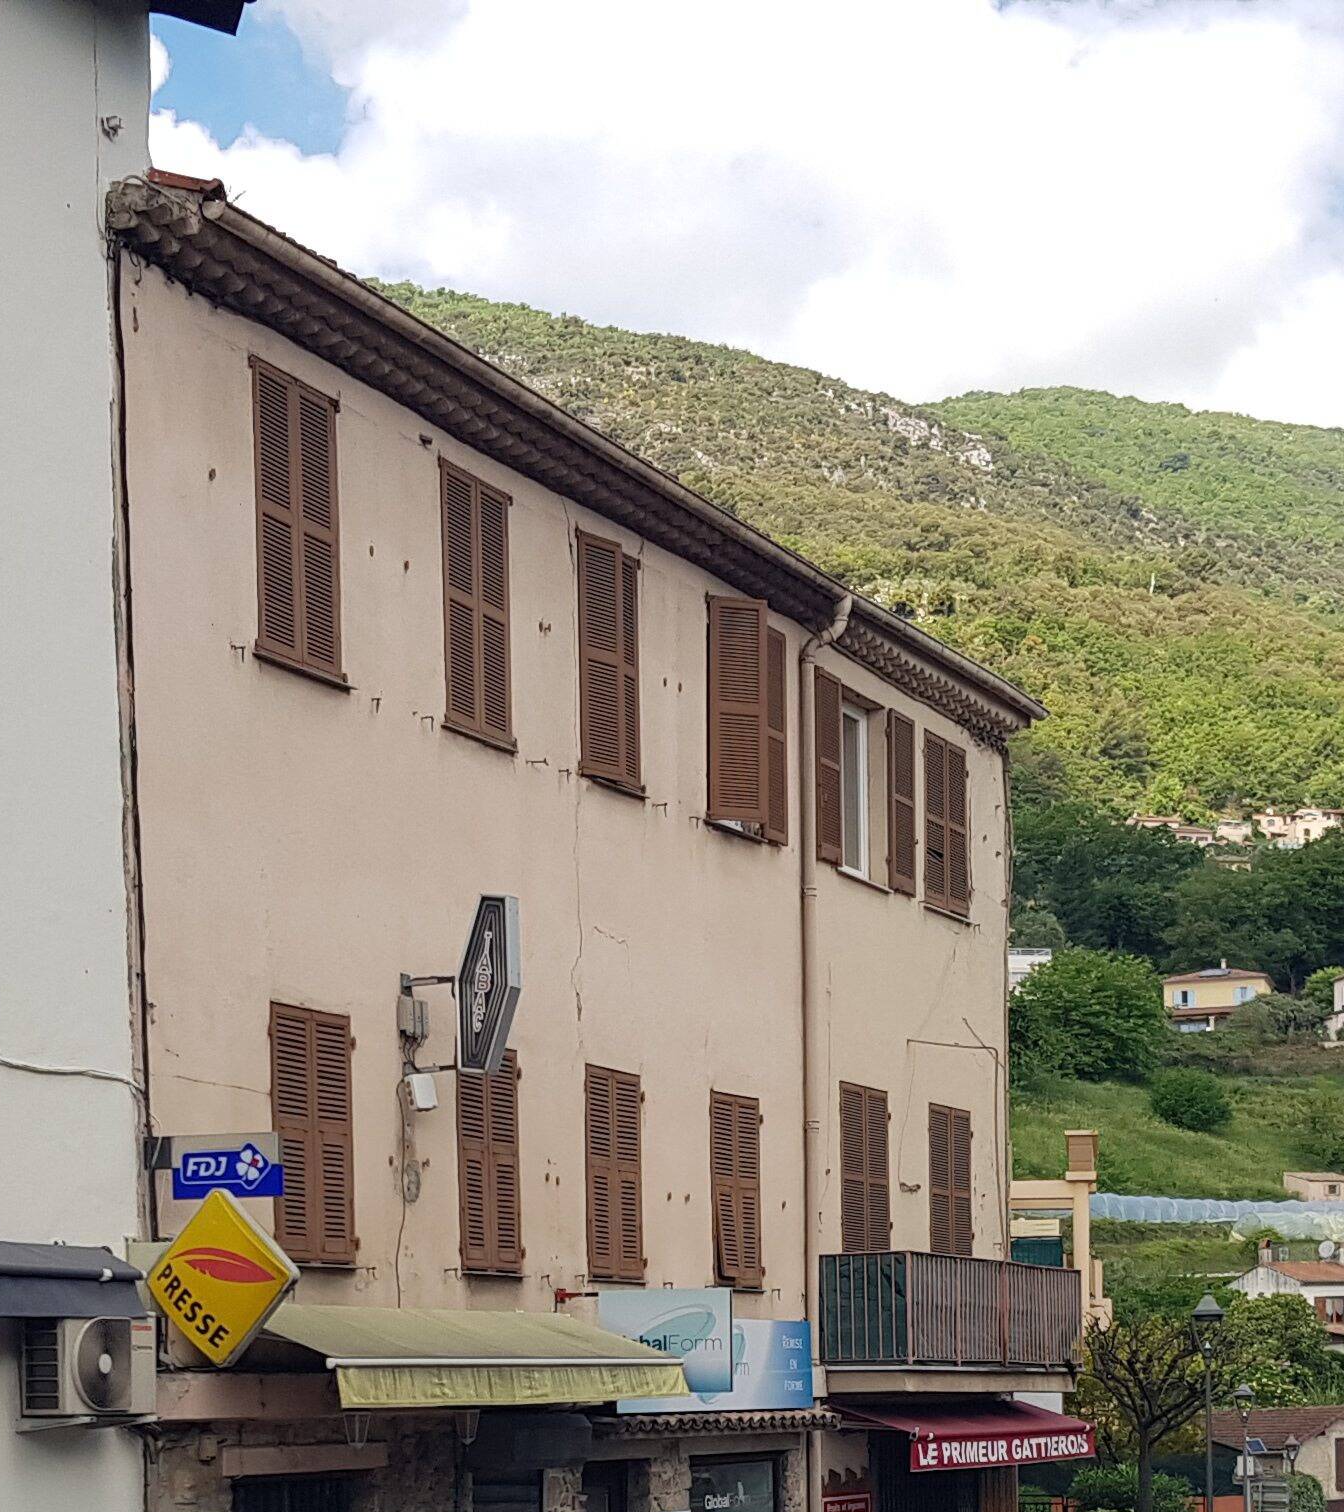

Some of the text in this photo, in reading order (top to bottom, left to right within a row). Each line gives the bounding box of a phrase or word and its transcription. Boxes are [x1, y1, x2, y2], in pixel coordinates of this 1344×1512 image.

[472, 931, 493, 1033] TABAC
[186, 1156, 227, 1178] FDJ
[157, 1263, 230, 1348] PRESSE
[917, 1433, 1089, 1466] LE PRIMEUR GATTIEROIS
